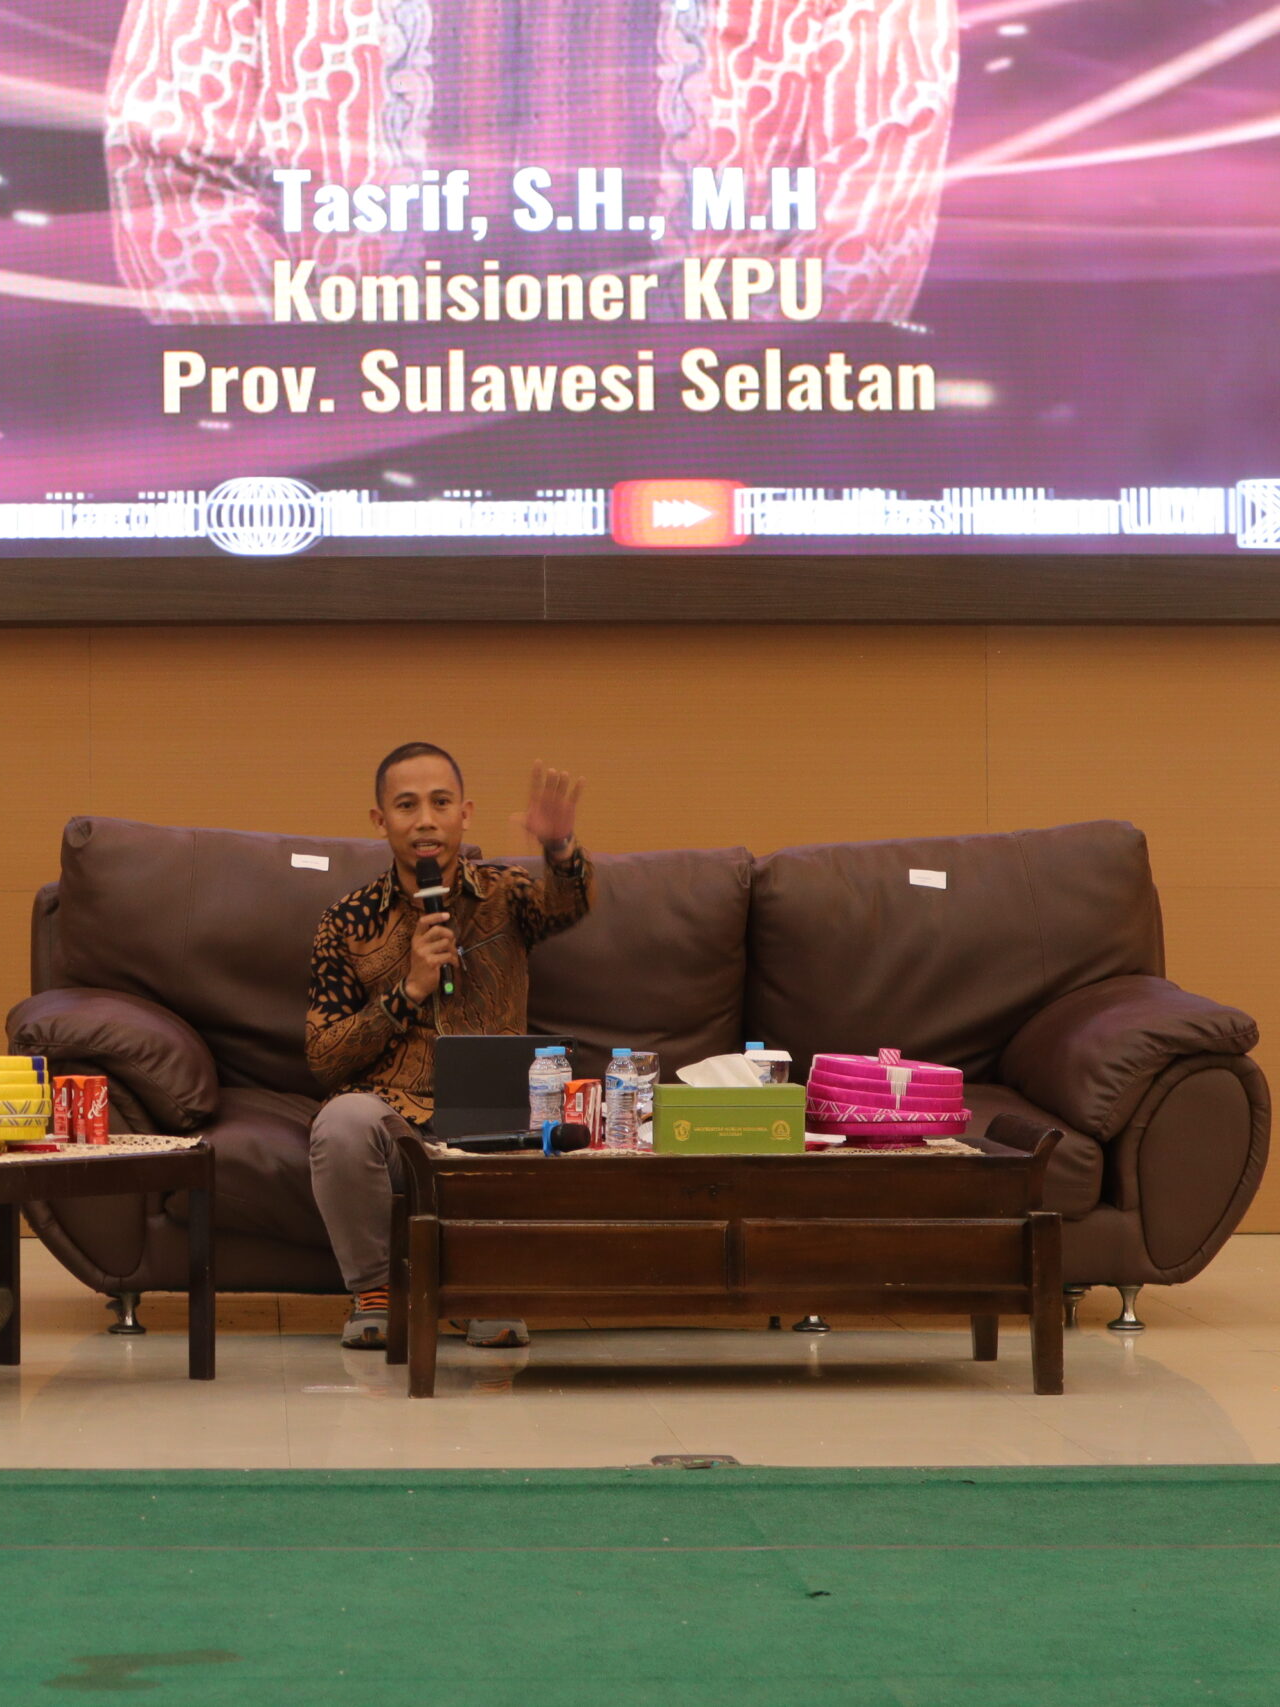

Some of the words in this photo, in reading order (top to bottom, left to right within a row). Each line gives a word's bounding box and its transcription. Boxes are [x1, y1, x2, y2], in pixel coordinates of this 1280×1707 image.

[272, 167, 488, 242] Tasrif,
[512, 165, 666, 241] S.H.,
[691, 165, 817, 231] M.H
[272, 259, 658, 322] Komisioner
[683, 257, 823, 320] KPU
[163, 352, 335, 413] Prov.
[362, 349, 654, 412] Sulawesi
[682, 348, 936, 411] Selatan
